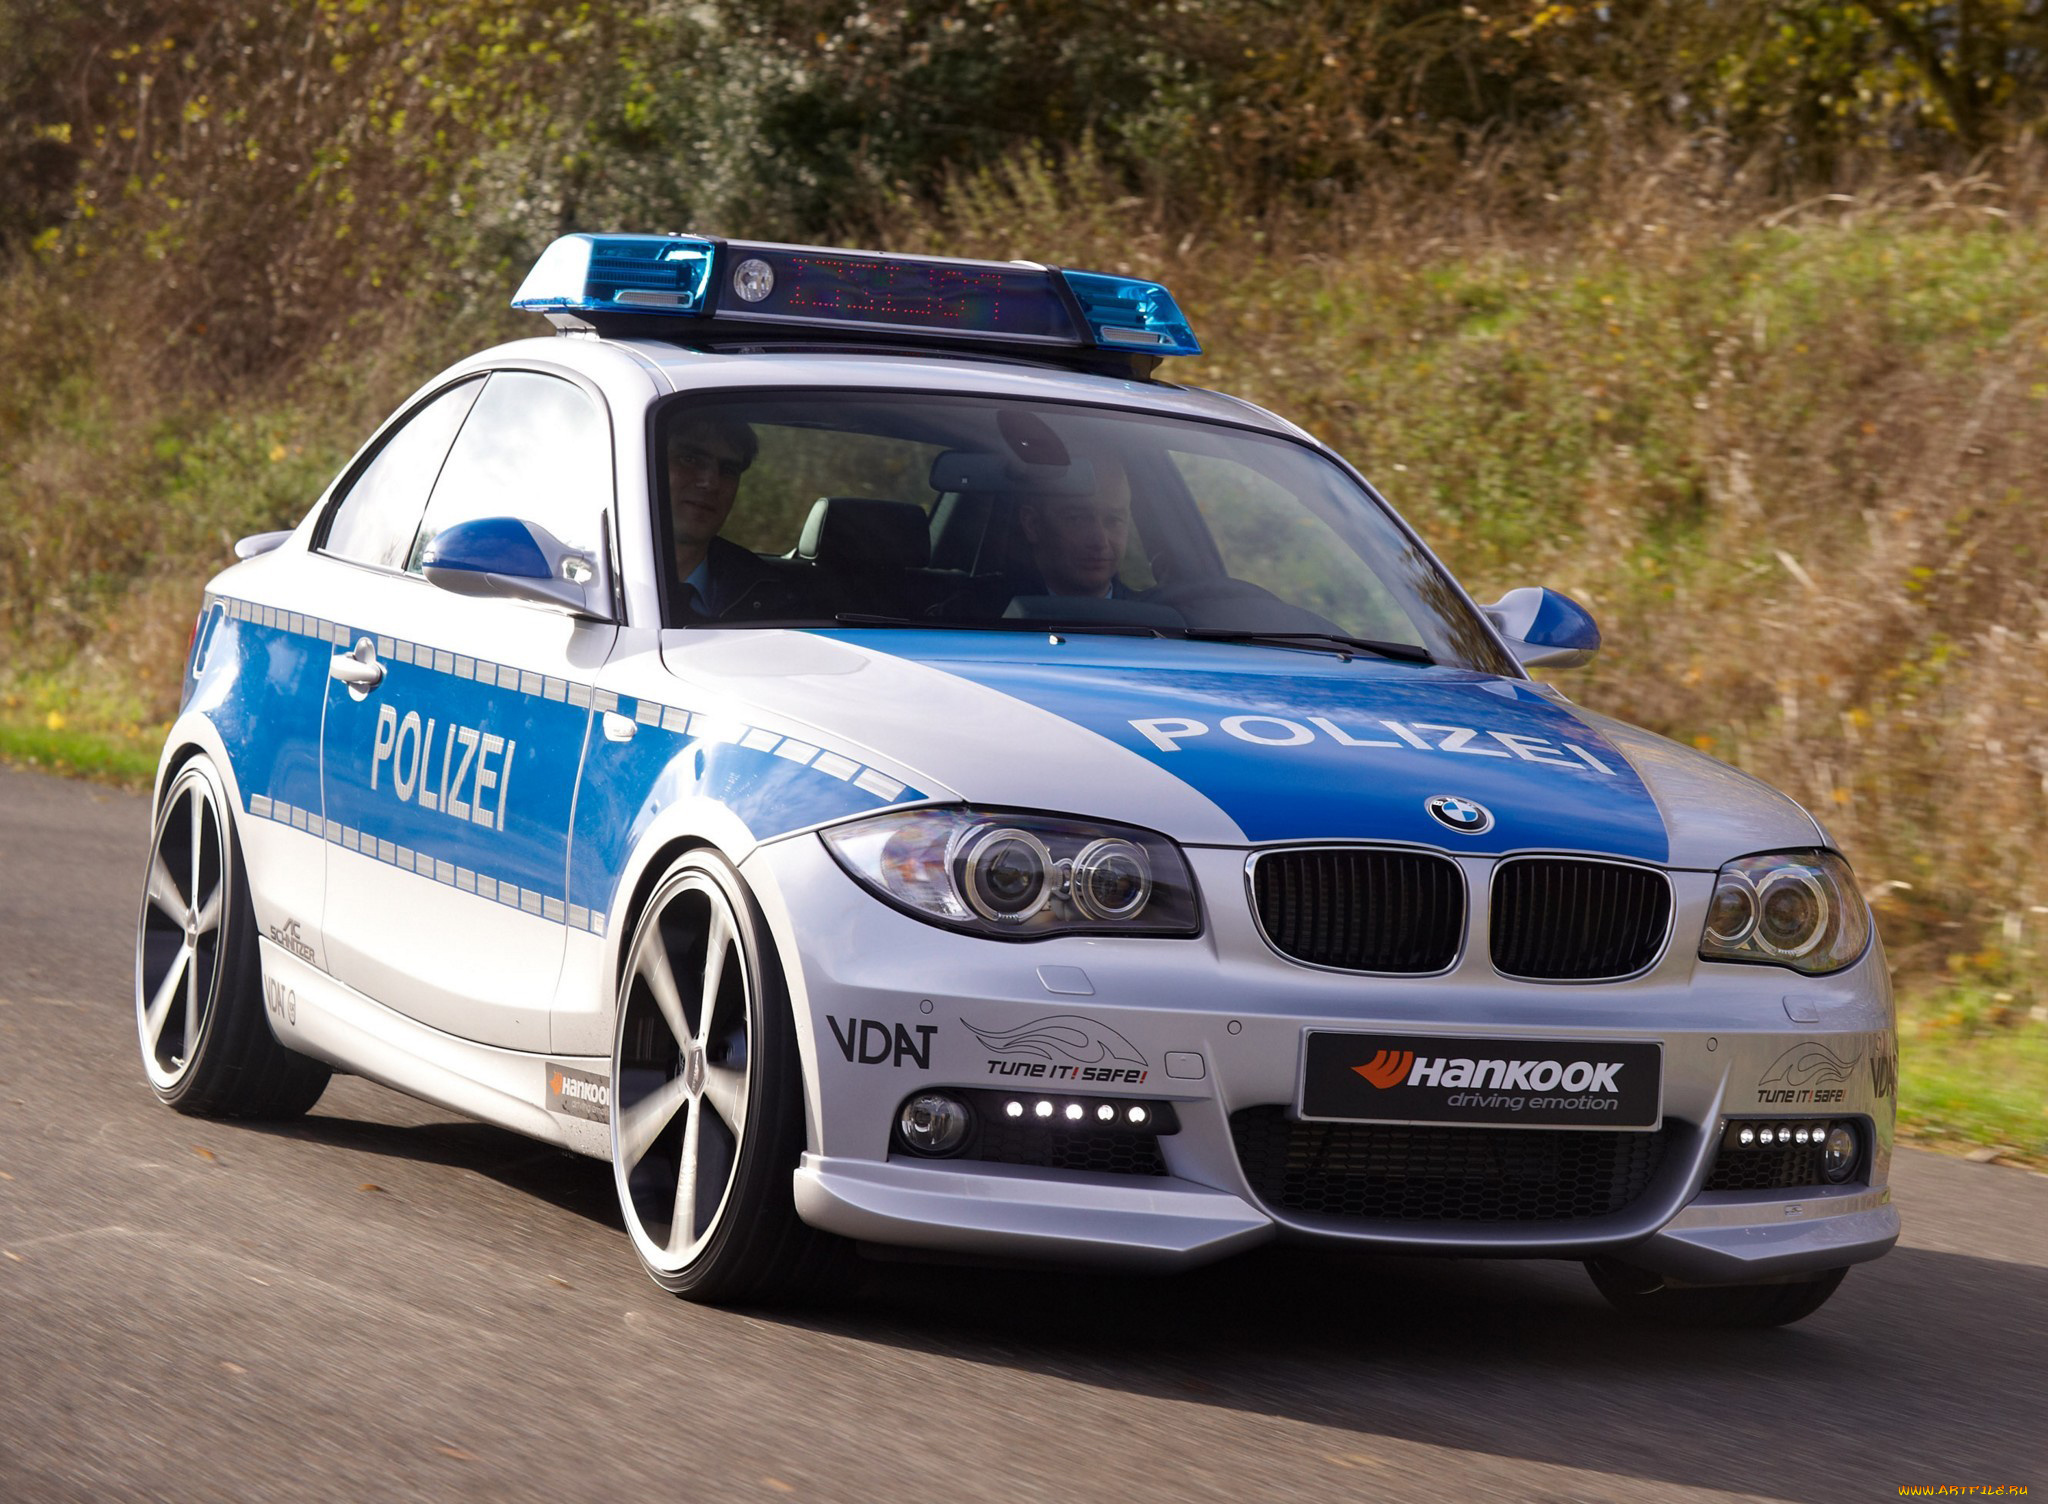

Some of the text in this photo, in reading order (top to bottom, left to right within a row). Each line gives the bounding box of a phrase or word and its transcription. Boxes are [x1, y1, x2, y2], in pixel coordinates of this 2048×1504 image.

[1128, 715, 1617, 776] POLIZEI
[370, 703, 516, 832] POLIZEI
[270, 925, 316, 963] SCHNITZER
[826, 1014, 938, 1070] VDAT
[987, 1059, 1148, 1084] TUNE IT! SAFE!
[1406, 1056, 1625, 1093] Hankook
[1447, 1092, 1619, 1111] driving emotion
[1758, 1089, 1794, 1103] TUNE
